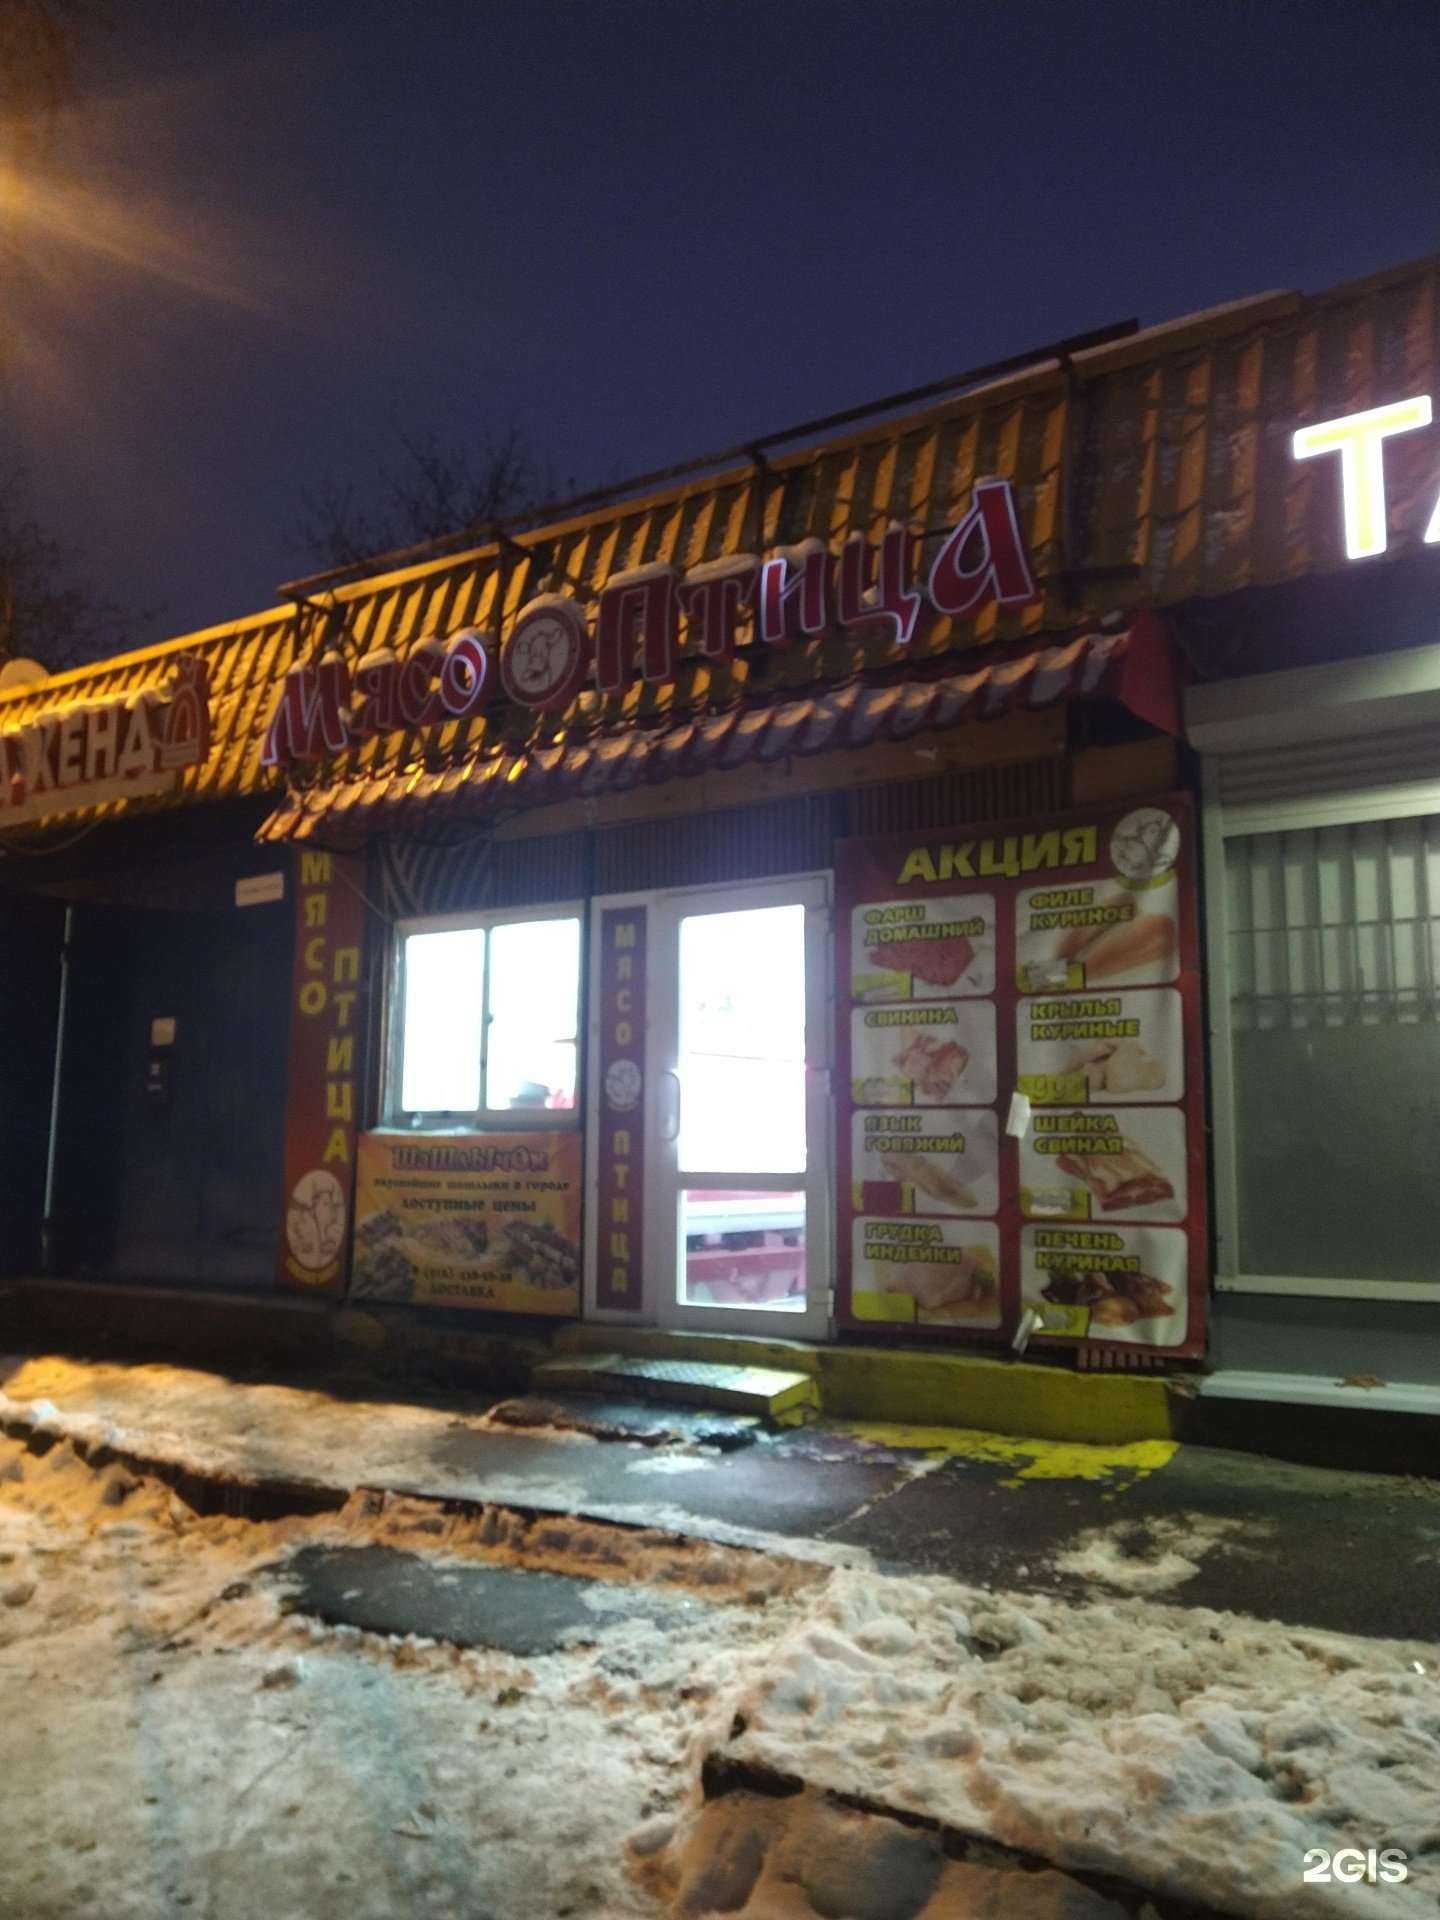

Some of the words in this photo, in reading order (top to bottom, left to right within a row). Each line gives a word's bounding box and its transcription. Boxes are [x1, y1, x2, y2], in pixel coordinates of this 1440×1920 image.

[1293, 394, 1440, 560] Т
[896, 825, 1098, 885] АКЦИЯ
[1028, 886, 1095, 911] ФИЛЕ
[864, 905, 926, 926] ФАРШ
[1029, 902, 1135, 932] КУРИНОЕ
[300, 851, 331, 1015] МЯСО
[863, 915, 986, 947] ДОМАШНИЙ
[864, 1007, 959, 1029] СВИНИНА
[1030, 997, 1122, 1022] КРЫЛЬЯ
[1031, 1018, 1140, 1042] КУРИНЫЕ
[322, 946, 360, 1164] ПТИЦА
[1034, 1110, 1119, 1133] ШЕЙКА
[1034, 1136, 1124, 1155] СВИНАЯ
[864, 1223, 943, 1244] ГРУДКА
[1035, 1231, 1124, 1250] ПЕЧЕНЬ
[864, 1242, 961, 1264] ИНДЕЙКИ
[1035, 1254, 1140, 1272] КУРИНАЯ
